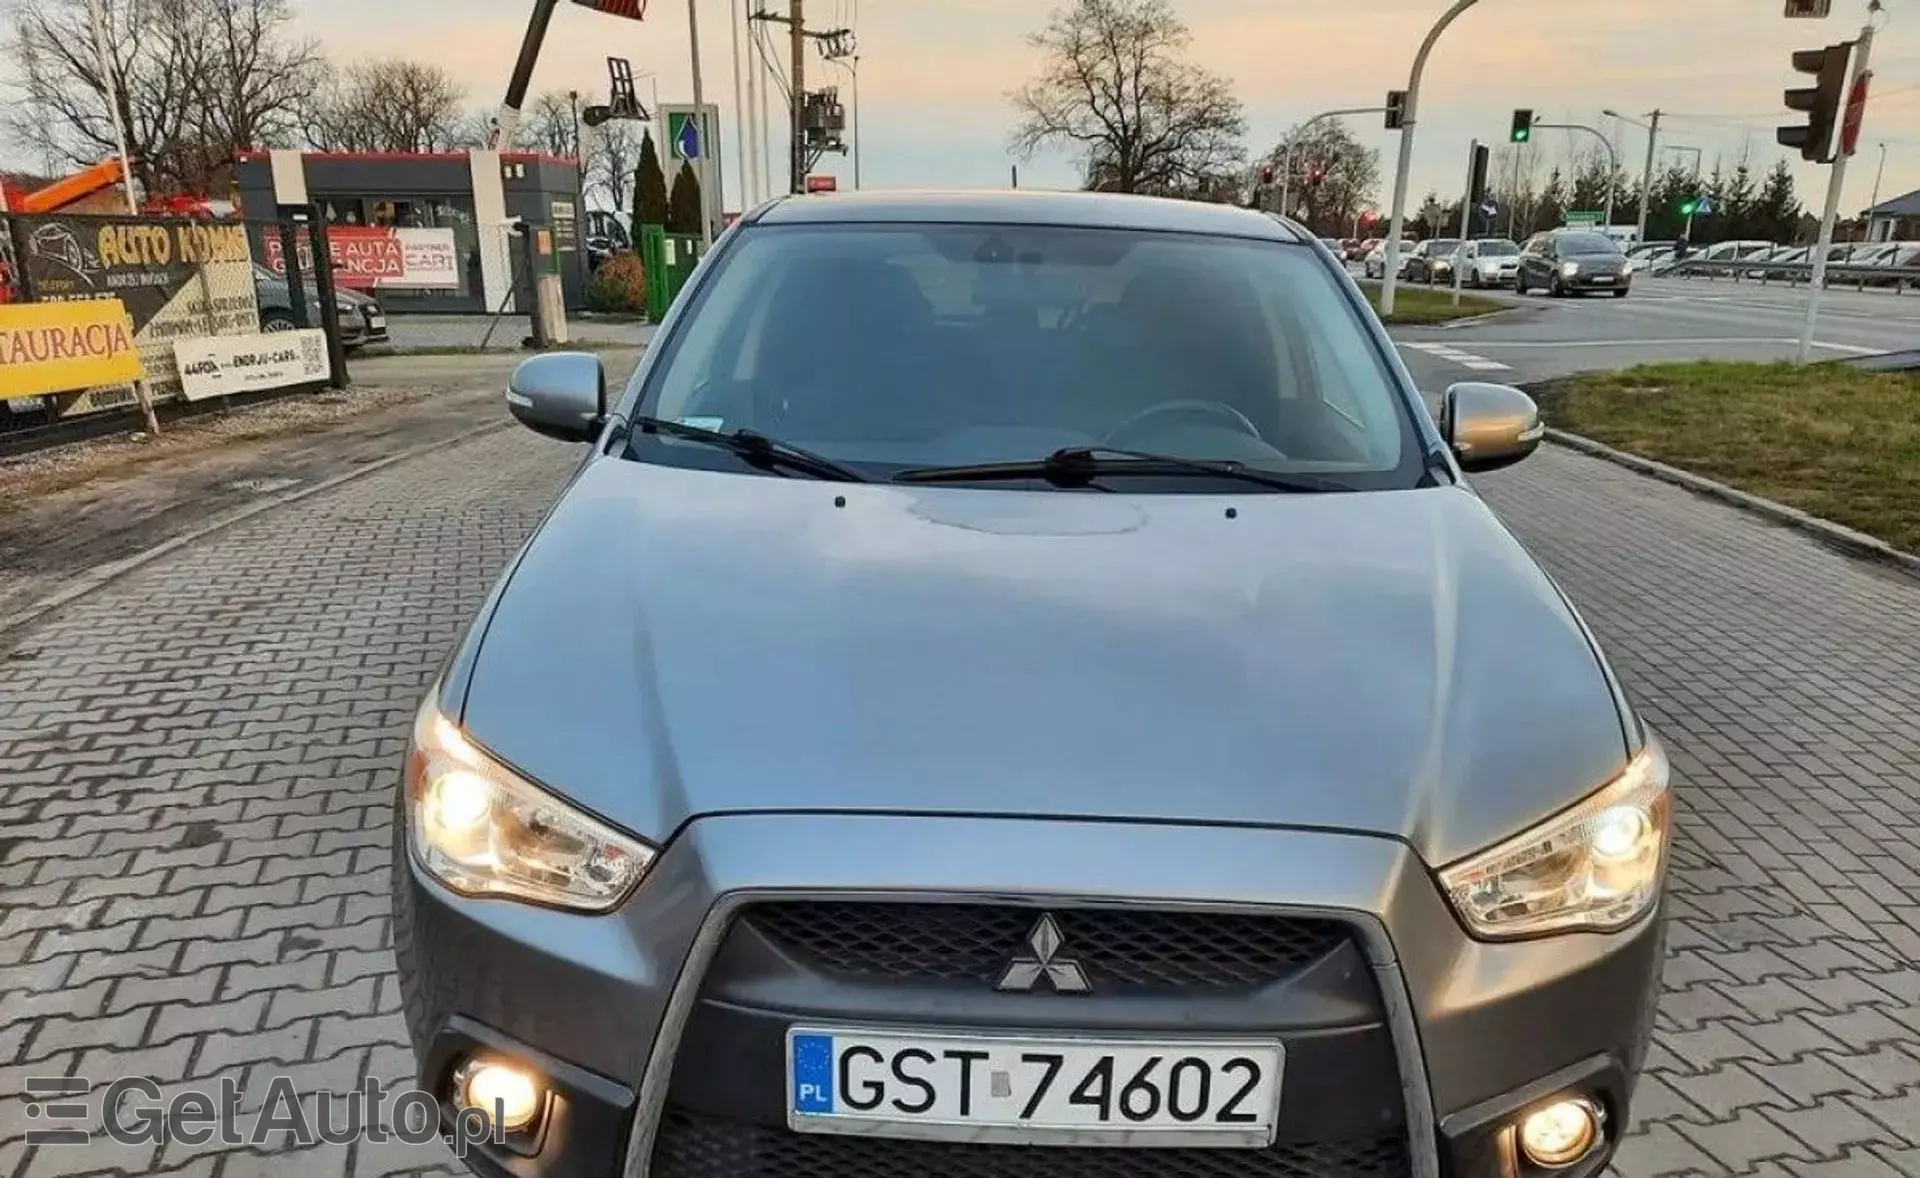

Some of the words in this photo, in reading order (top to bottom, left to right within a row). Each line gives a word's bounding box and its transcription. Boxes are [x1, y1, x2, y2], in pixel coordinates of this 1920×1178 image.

[98, 224, 171, 269] AUTO
[345, 240, 398, 258] AUTA
[800, 1083, 827, 1104] PL
[838, 1045, 990, 1117] GST
[1018, 1052, 1262, 1123] 74602
